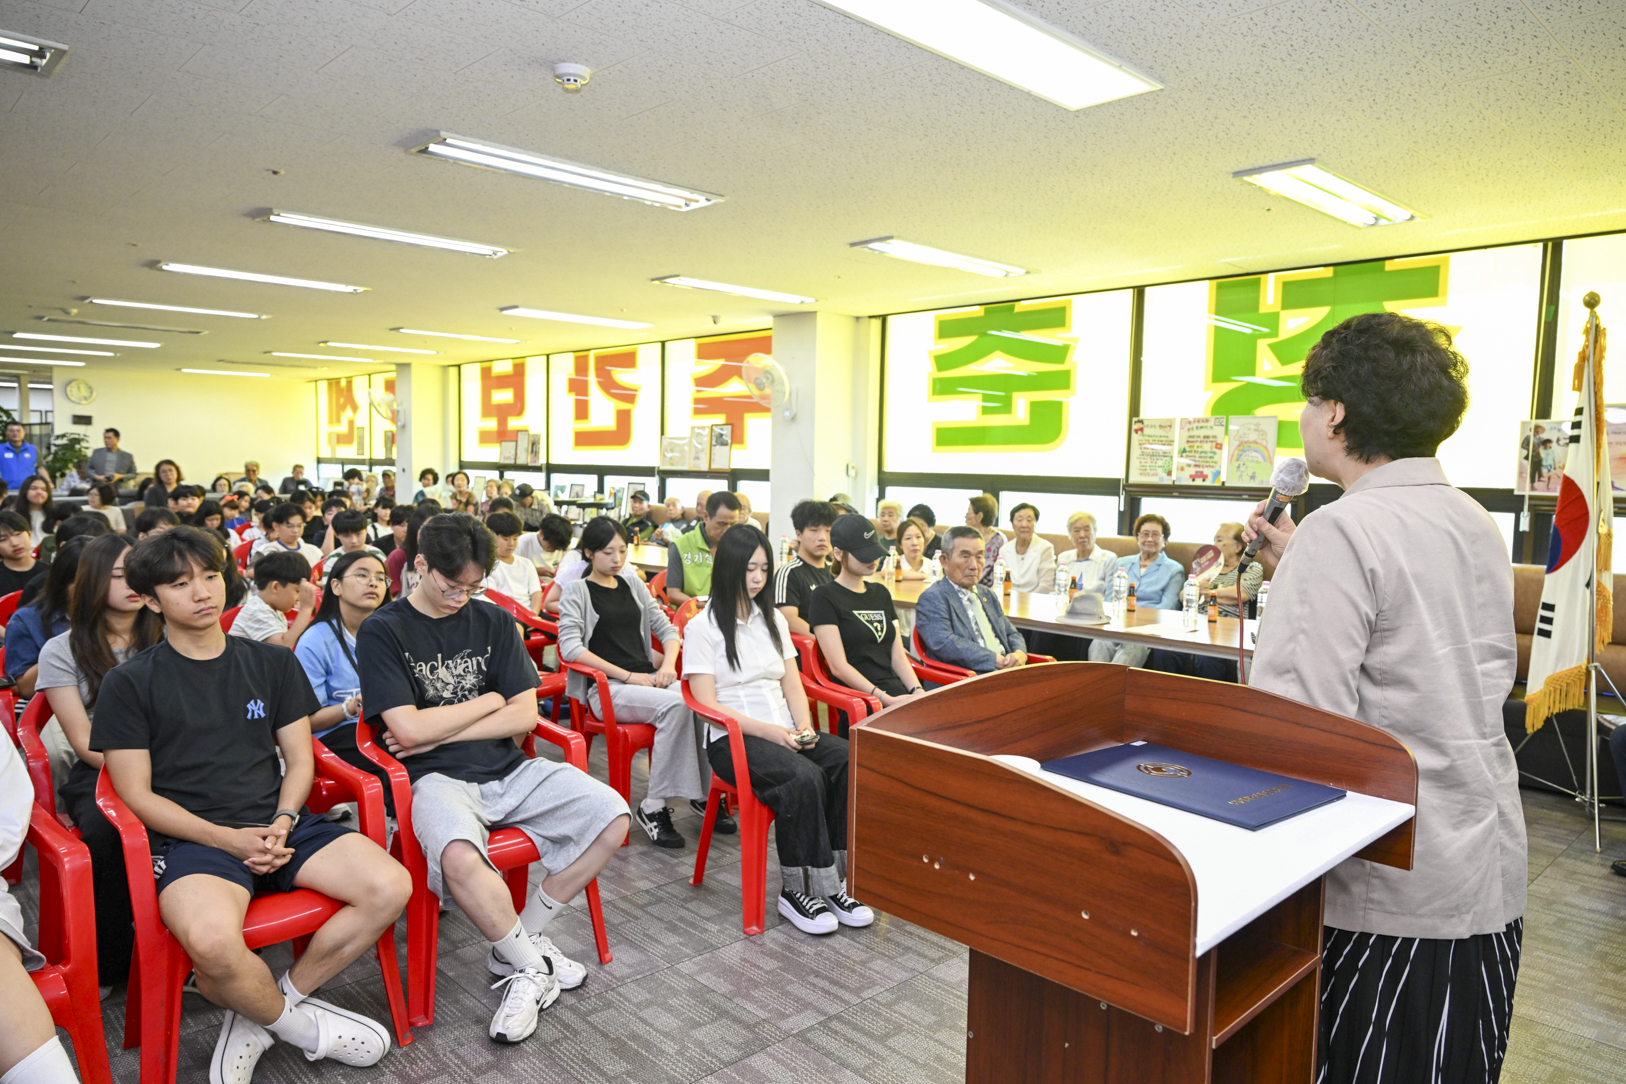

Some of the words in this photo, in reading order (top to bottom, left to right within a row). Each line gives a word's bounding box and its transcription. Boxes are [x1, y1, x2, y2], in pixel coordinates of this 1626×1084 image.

[860, 613, 883, 621] GUESS
[404, 646, 491, 679] ackyard
[246, 698, 267, 720] NY
